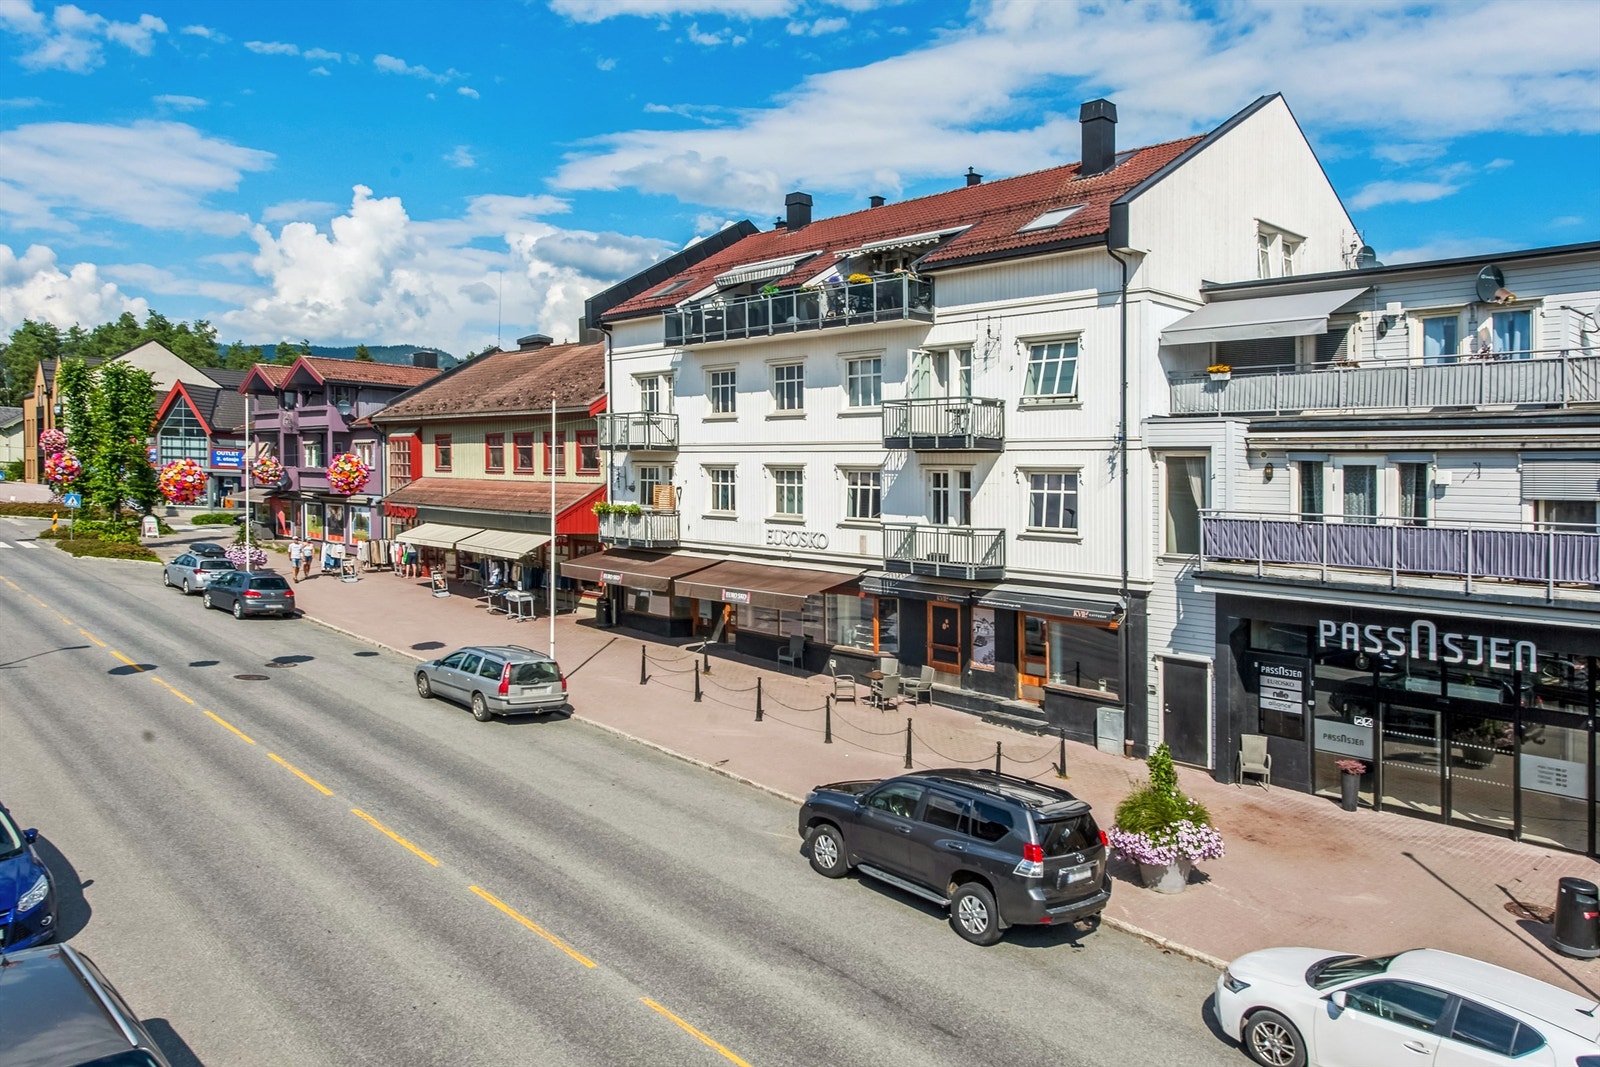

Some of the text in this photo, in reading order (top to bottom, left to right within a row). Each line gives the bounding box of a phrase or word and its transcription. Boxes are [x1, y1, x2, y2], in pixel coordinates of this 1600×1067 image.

[767, 529, 829, 550] EUROSKO
[1267, 679, 1295, 687] EUROSKO
[1273, 691, 1289, 699] nille
